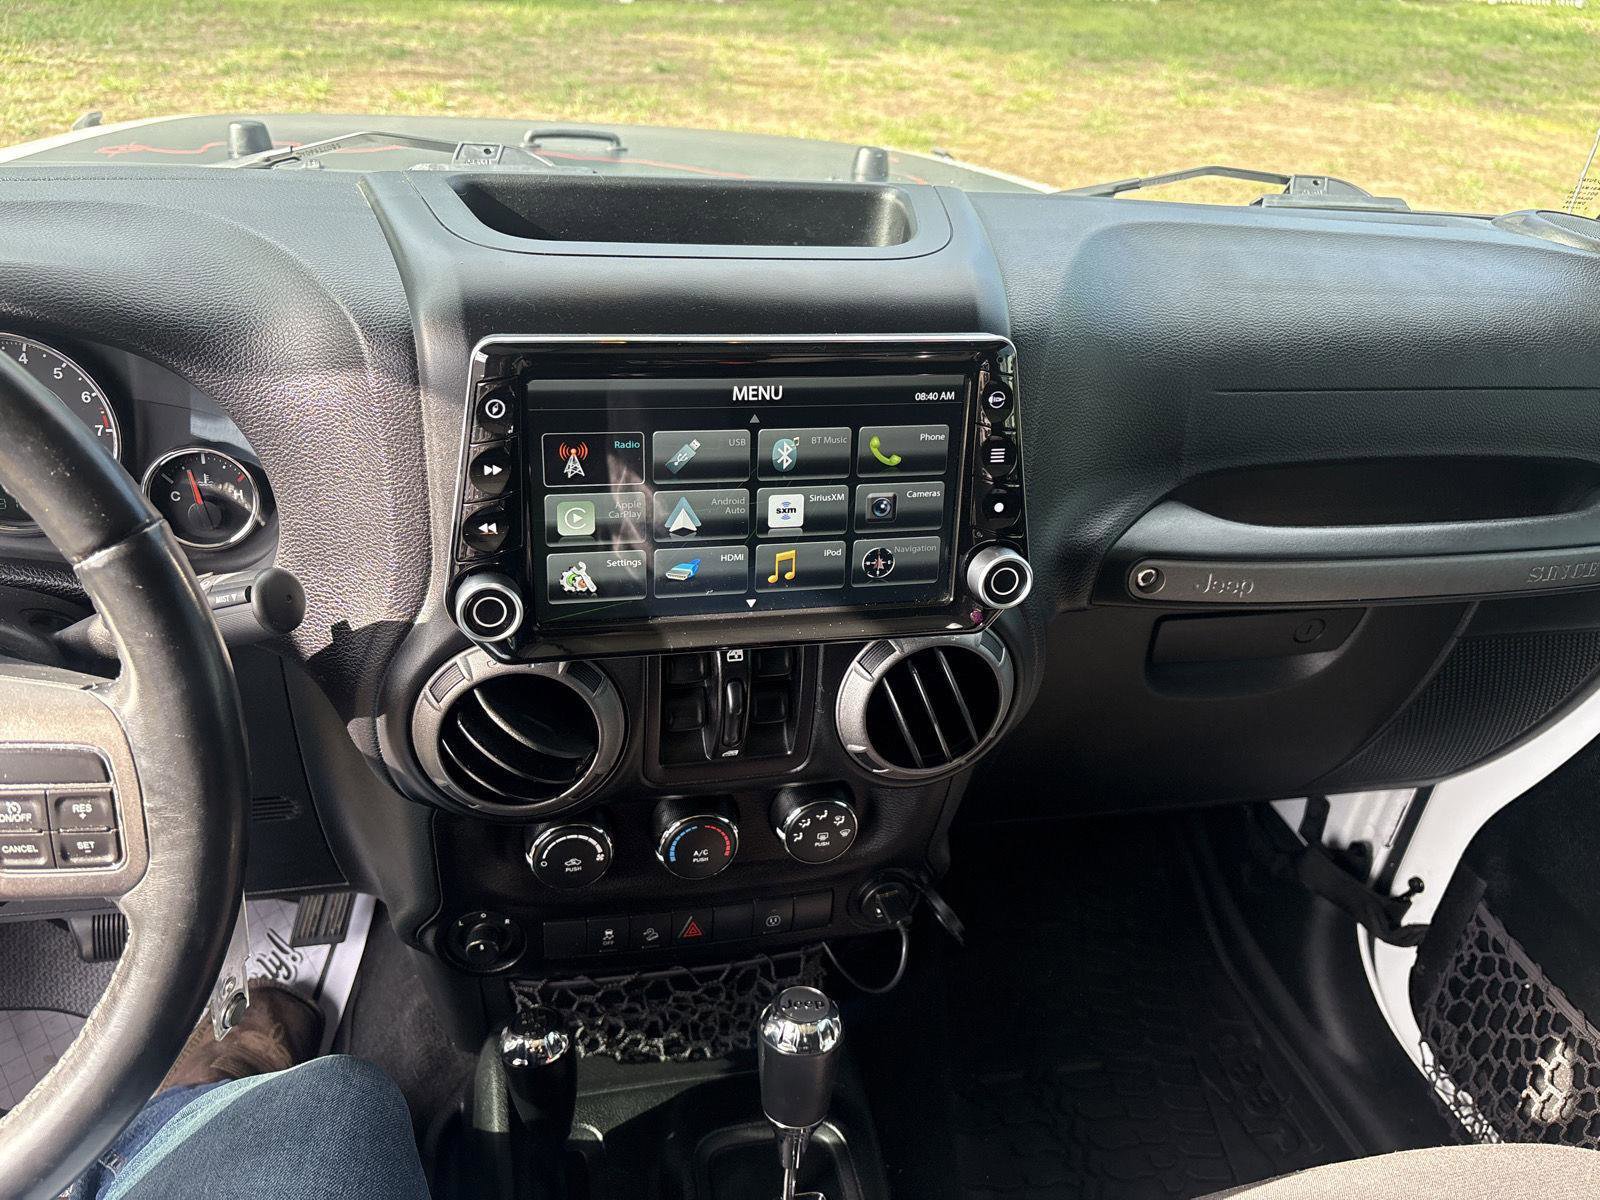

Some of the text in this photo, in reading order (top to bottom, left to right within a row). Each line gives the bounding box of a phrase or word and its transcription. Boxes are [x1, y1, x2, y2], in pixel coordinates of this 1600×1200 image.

[18, 353, 28, 364] 4
[53, 367, 63, 380] 5
[81, 390, 91, 403] 6
[732, 385, 783, 401] MENU
[915, 391, 955, 401] 08:40 AM
[95, 424, 103, 437] 7
[811, 436, 847, 445] BT Music
[920, 433, 946, 441] Phone
[614, 440, 640, 449] Radio
[728, 438, 746, 447] USB
[170, 490, 181, 502] C
[233, 489, 244, 501] H
[809, 493, 845, 502] SiriusXM
[906, 490, 941, 499] Cameras
[615, 500, 642, 511] Apple
[711, 497, 746, 506] Android
[608, 510, 642, 520] CarPlay
[725, 507, 746, 515] Auto
[776, 507, 797, 515] sxm
[823, 548, 842, 557] iPod
[894, 544, 937, 554] Navigation
[720, 553, 744, 562] HDMI
[606, 558, 642, 568] Settings
[72, 803, 92, 813] RES
[0, 813, 32, 823] ON/OFF
[2, 844, 38, 853] CANCEL
[77, 841, 95, 850] SET
[693, 849, 708, 857] A/C
